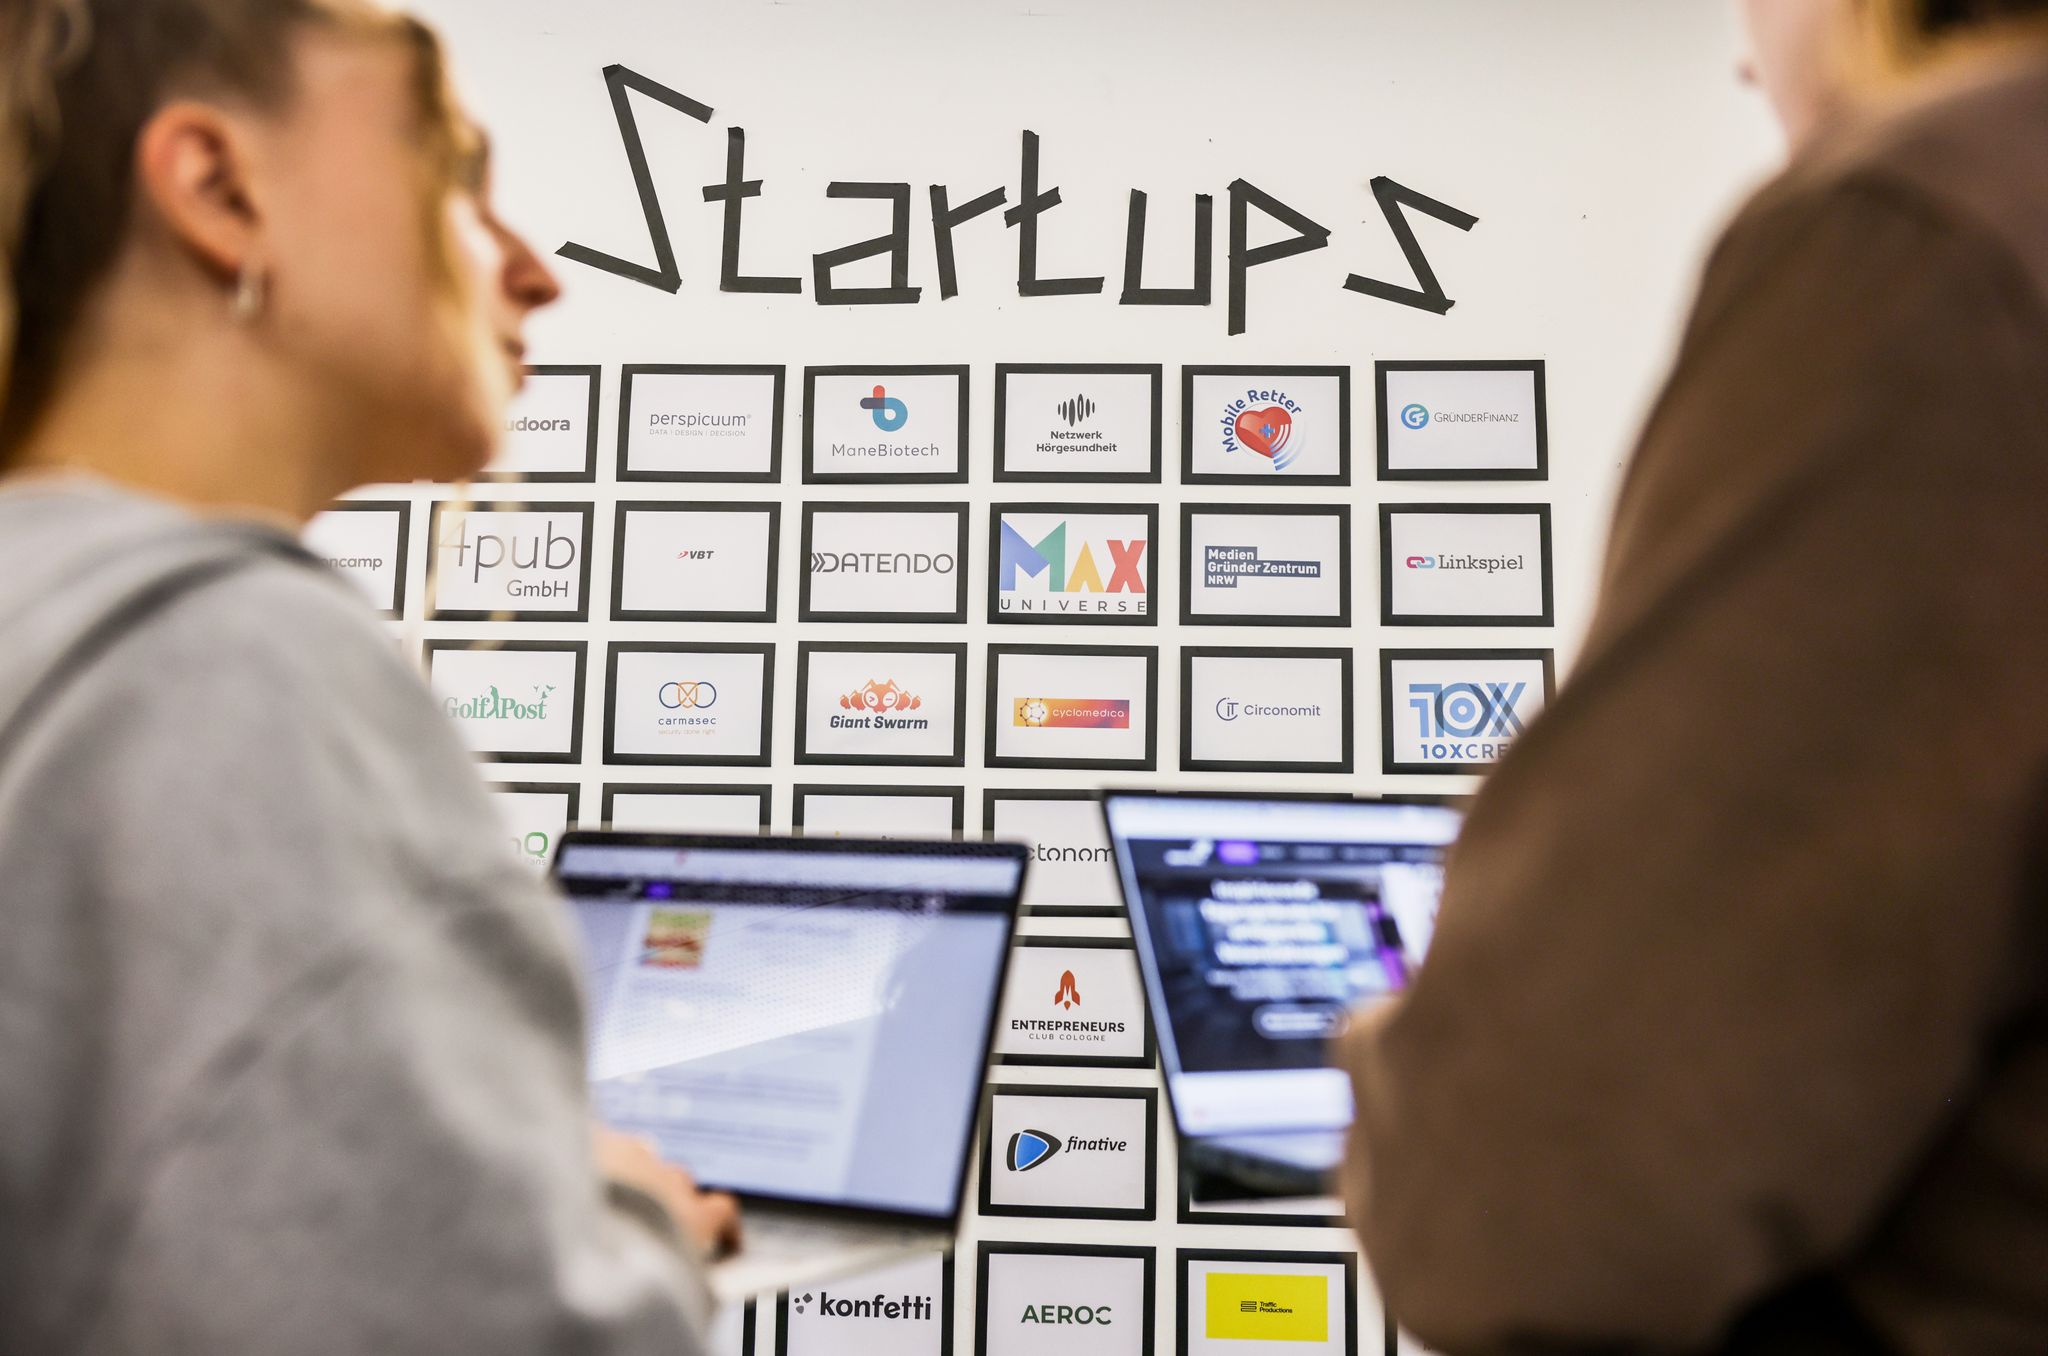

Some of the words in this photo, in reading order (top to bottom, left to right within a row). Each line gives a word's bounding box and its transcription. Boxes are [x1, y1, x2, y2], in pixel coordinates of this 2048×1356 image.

[555, 64, 1479, 336] Startups
[504, 416, 571, 432] udoora
[1220, 399, 1246, 453] Mobile
[1247, 389, 1302, 414] Retter
[674, 429, 703, 437] DESIGN
[1050, 430, 1103, 440] Netzwerk
[832, 443, 940, 457] ManeBiotech
[1036, 443, 1118, 454] Hörgesundheit
[439, 518, 576, 583] 4pub
[690, 550, 714, 560] VBT
[1000, 519, 1147, 593] MAX
[1208, 549, 1255, 560] Medien
[320, 557, 383, 572] ncamp
[821, 552, 954, 574] DATENDO
[1207, 561, 1262, 573] Gründer
[1262, 562, 1318, 574] Zentrum
[1438, 554, 1524, 573] Linkspiel
[1207, 575, 1235, 585] NRW
[506, 579, 569, 598] GmbH
[1000, 599, 1146, 613] UNIVERSE
[442, 696, 490, 719] Golf
[500, 697, 548, 720] Post
[1052, 708, 1125, 718] cyclomedica
[1244, 704, 1321, 716] Circonomit
[658, 717, 717, 725] carmasec
[830, 715, 871, 728] Giant
[873, 716, 929, 729] Swarm
[1420, 743, 1512, 760] 10XCRE
[1026, 843, 1113, 862] ctonom
[1011, 1019, 1125, 1033] ENTREPRENEURS
[1065, 1135, 1127, 1153] finative
[820, 1291, 932, 1320] konfetti
[1021, 1304, 1112, 1325] AEROC
